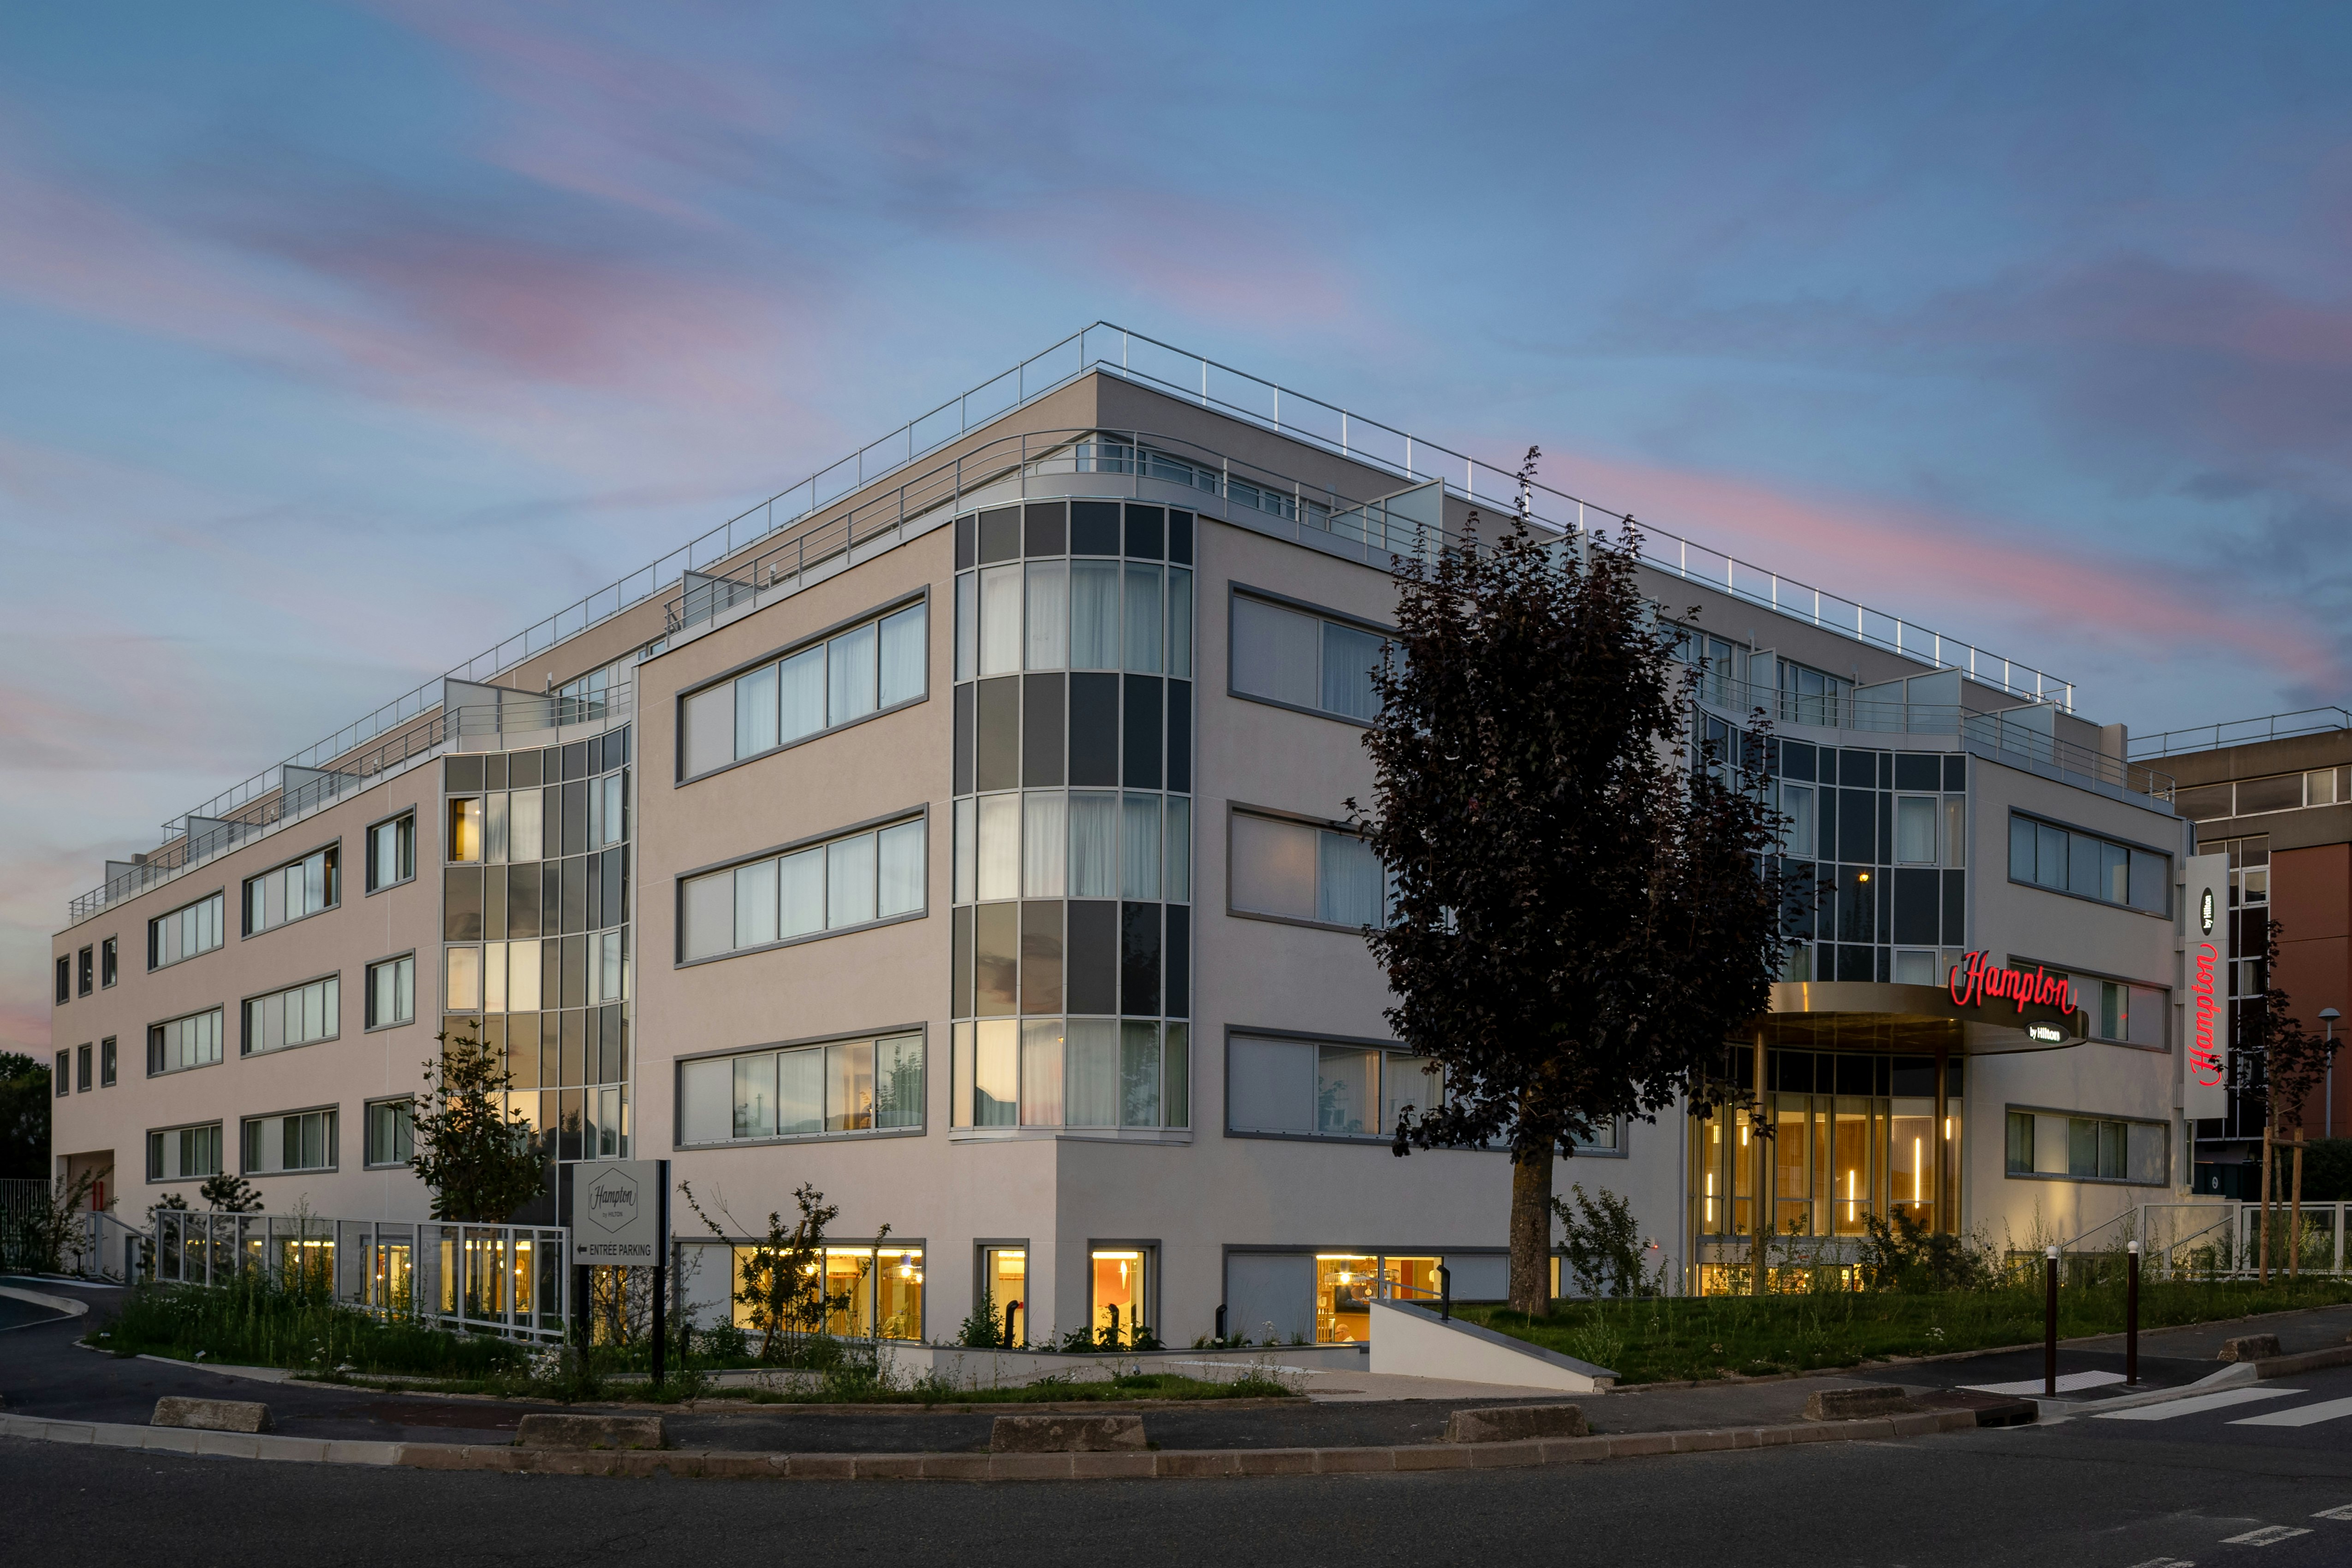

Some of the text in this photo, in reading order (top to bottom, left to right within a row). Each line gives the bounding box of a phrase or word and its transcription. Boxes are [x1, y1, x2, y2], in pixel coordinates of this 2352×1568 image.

[2203, 919, 2213, 928] by
[1949, 950, 2077, 1014] Hampton
[2188, 943, 2222, 1086] Hampton
[2030, 1026, 2060, 1041] by Hilton
[590, 1184, 636, 1209] Hampton
[590, 1241, 650, 1256] ENTRÉE PARKING
